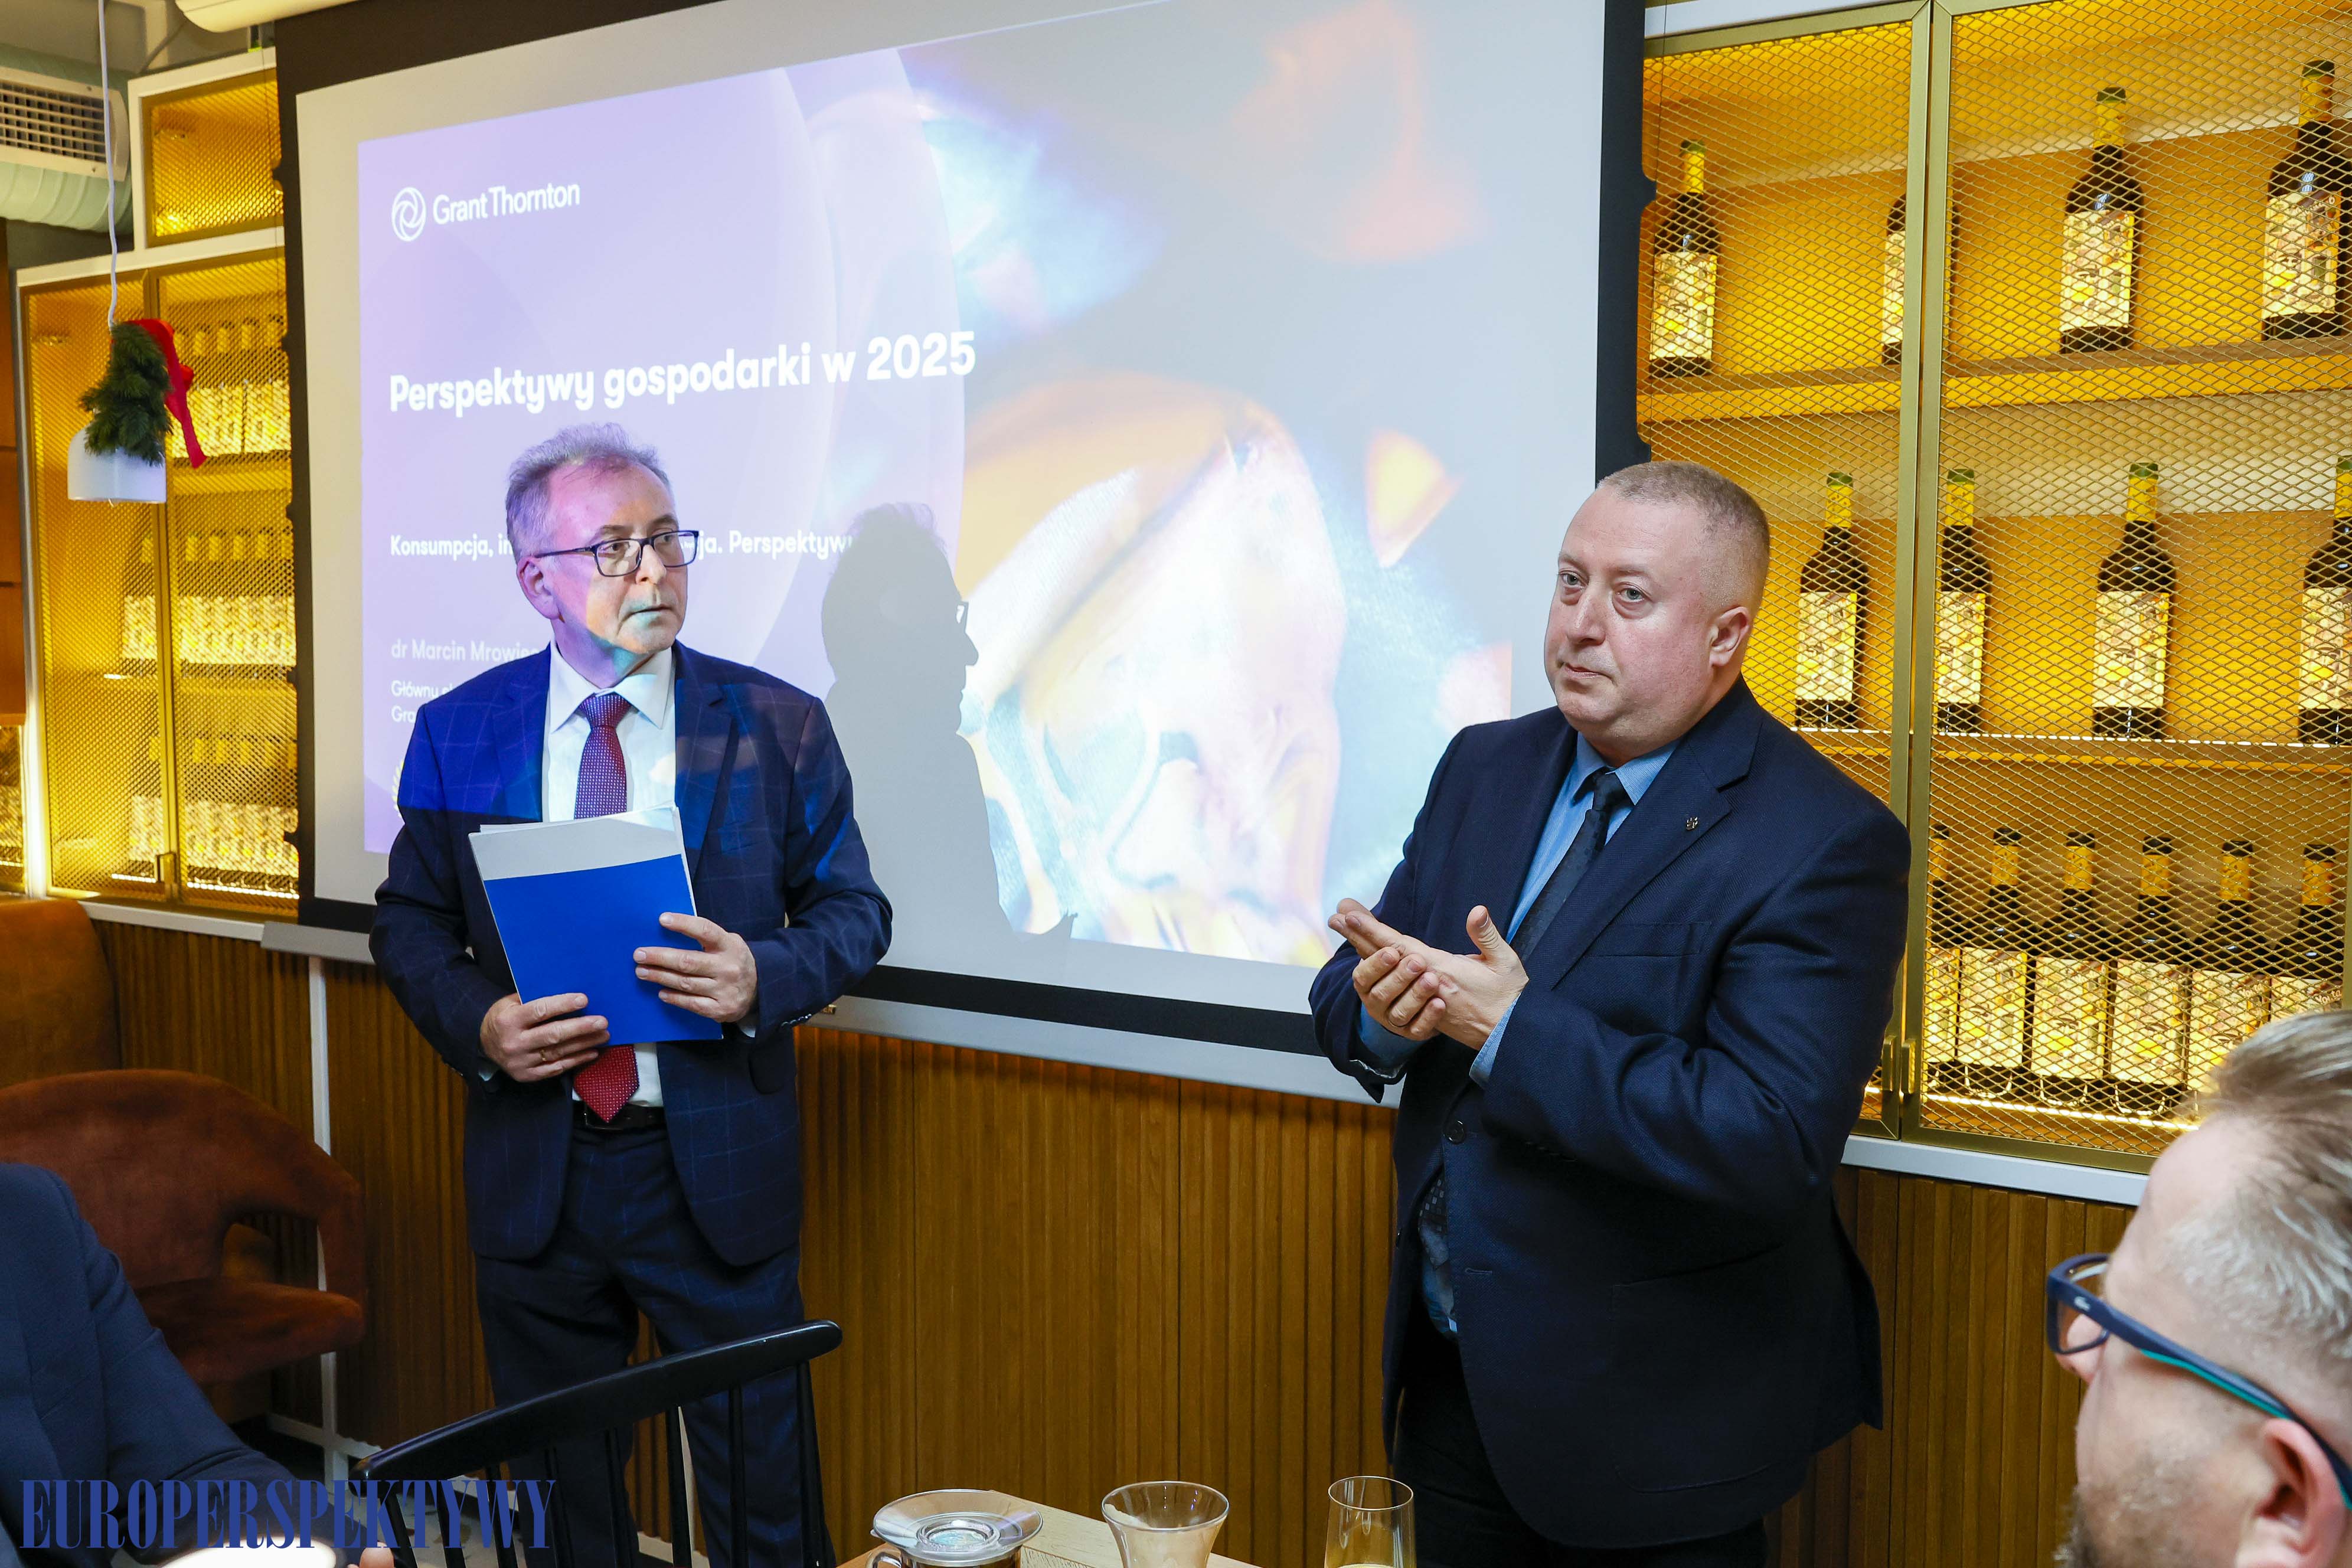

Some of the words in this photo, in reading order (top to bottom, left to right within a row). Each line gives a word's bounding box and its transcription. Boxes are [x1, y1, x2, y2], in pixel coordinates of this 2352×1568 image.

[433, 194, 488, 224] Grant
[488, 182, 580, 217] Thornton
[390, 367, 594, 418] Perspektywy
[603, 342, 811, 409] gospodarki
[821, 351, 857, 383] w
[866, 331, 976, 381] 2025
[390, 533, 494, 561] Konsumpcja,
[391, 638, 408, 659] dr
[411, 639, 466, 661] Marcin
